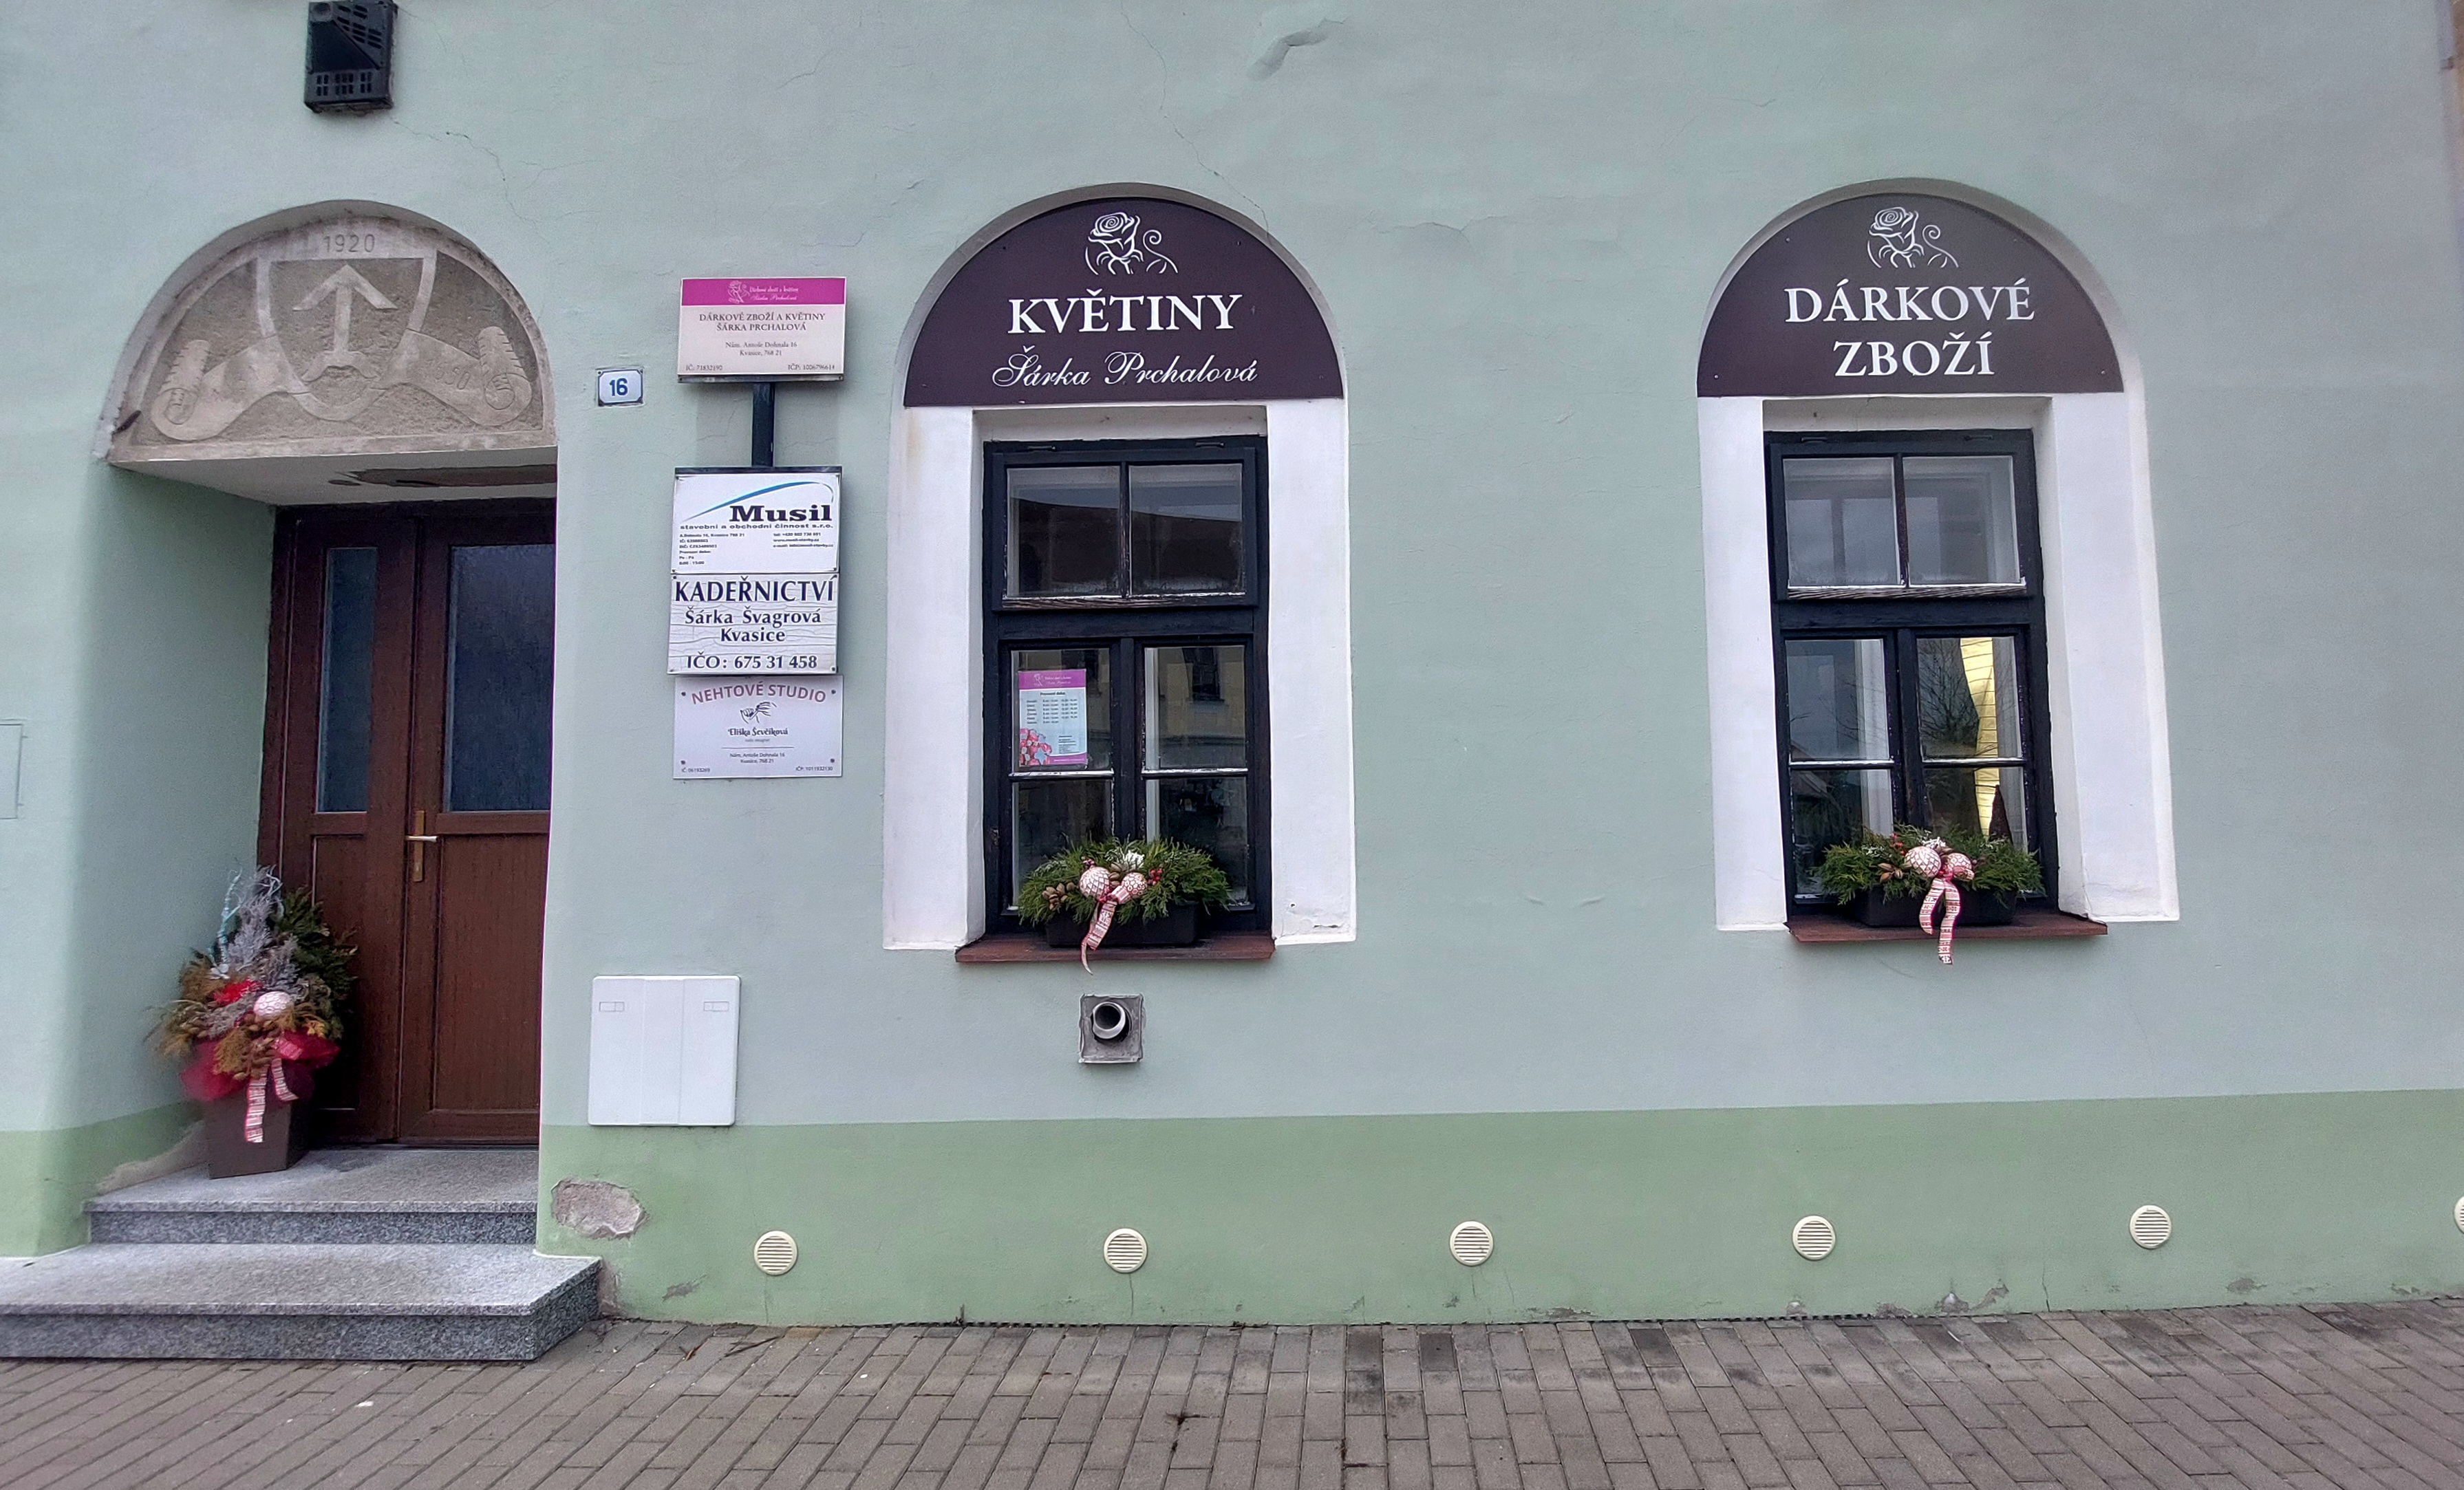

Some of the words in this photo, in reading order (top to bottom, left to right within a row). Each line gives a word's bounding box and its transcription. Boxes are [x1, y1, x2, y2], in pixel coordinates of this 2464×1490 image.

[323, 234, 375, 252] 1920
[1783, 277, 2035, 322] DÁRKOVÉ
[699, 312, 744, 321] DÁRKOVÉ
[747, 312, 774, 321] ZBOŽÍ
[785, 312, 826, 321] KVĚTINY
[1007, 288, 1243, 334] KVĚTINY
[716, 322, 747, 331] ŠÁRKA
[749, 322, 806, 331] PRCHALOVÁ
[1833, 331, 1995, 377] ZBOŽÍ
[992, 345, 1091, 387] Šárka
[1104, 350, 1258, 385] Prchalová
[609, 378, 628, 396] 16
[729, 504, 833, 522] Musil
[675, 574, 837, 602] KADEŘNICTVÍ
[685, 605, 733, 624] Šárka
[742, 605, 822, 628] Švagrová
[720, 627, 786, 643] Kvasice
[734, 656, 761, 669] 675
[766, 656, 782, 669] 31
[789, 656, 817, 669] 458
[692, 681, 764, 705] NEHTOVÉ
[767, 684, 826, 702] STUDIO
[727, 728, 751, 737] Eliška
[751, 727, 789, 737] Ševčíková
